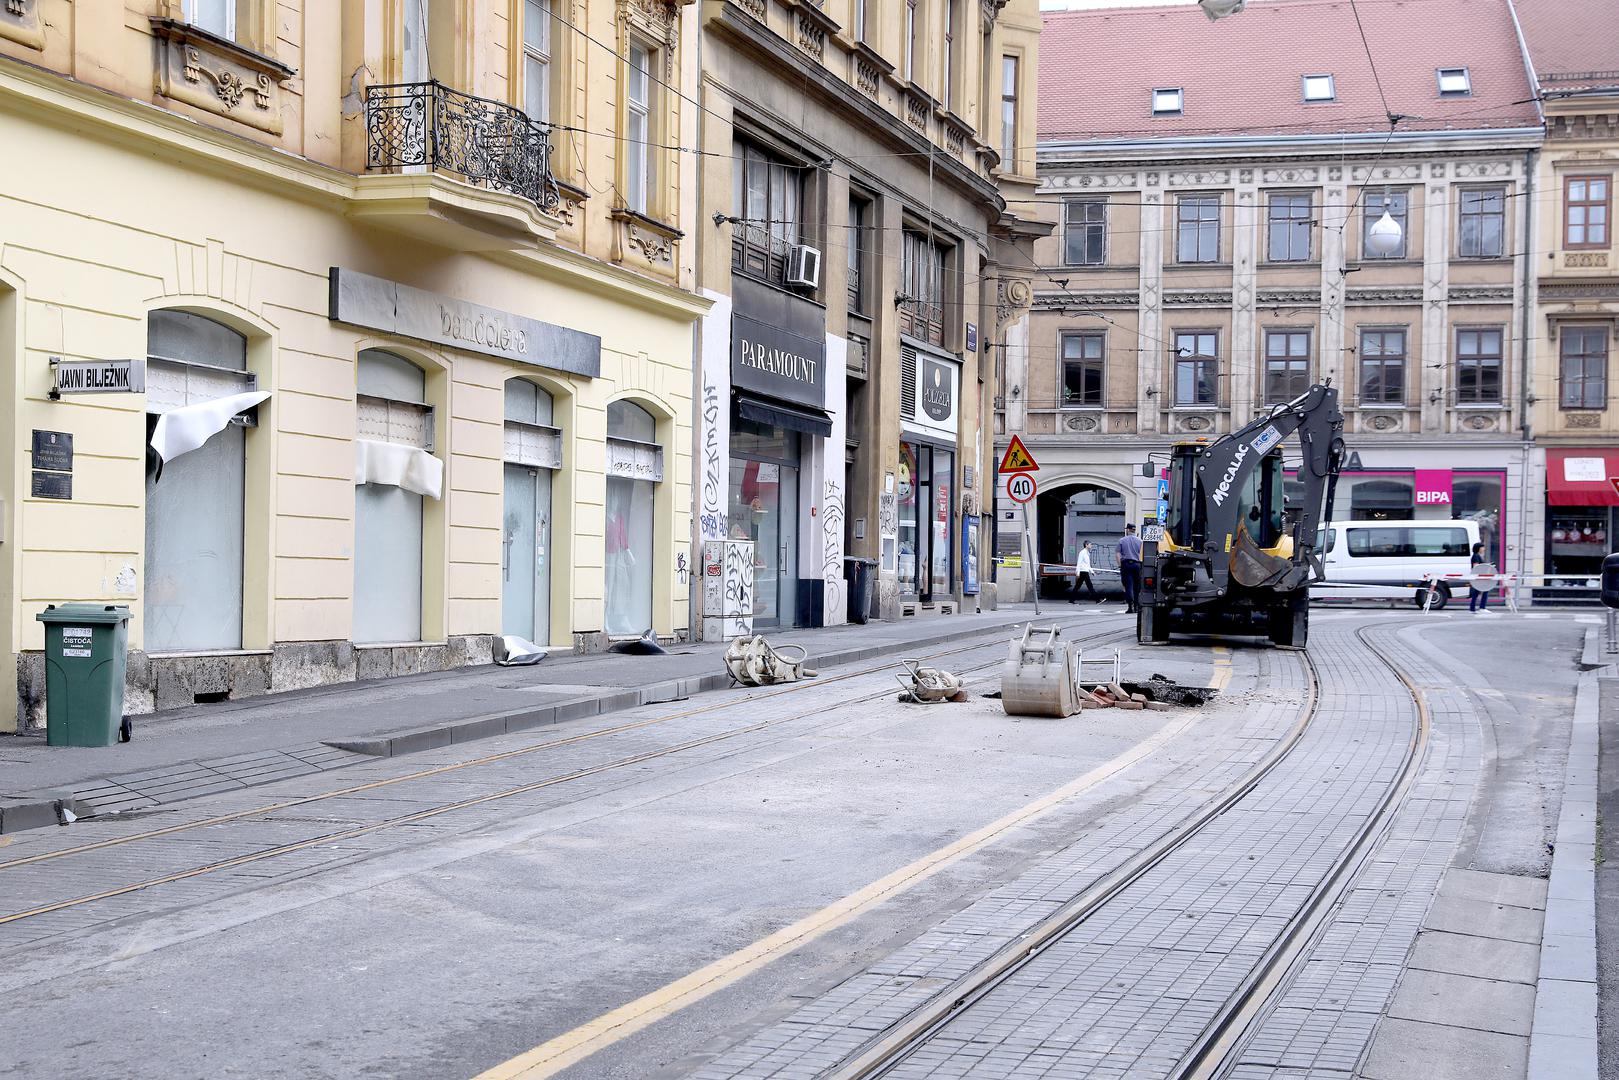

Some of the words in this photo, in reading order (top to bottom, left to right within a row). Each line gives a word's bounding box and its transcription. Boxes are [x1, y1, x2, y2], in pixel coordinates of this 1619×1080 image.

[440, 305, 528, 354] bandolera
[740, 339, 816, 384] PARAMOUNT
[59, 369, 83, 388] JAVNI
[86, 364, 129, 388] BILJEŽNIK
[1013, 480, 1030, 495] 40
[1416, 491, 1450, 503] BIPA
[1149, 527, 1158, 535] ZG
